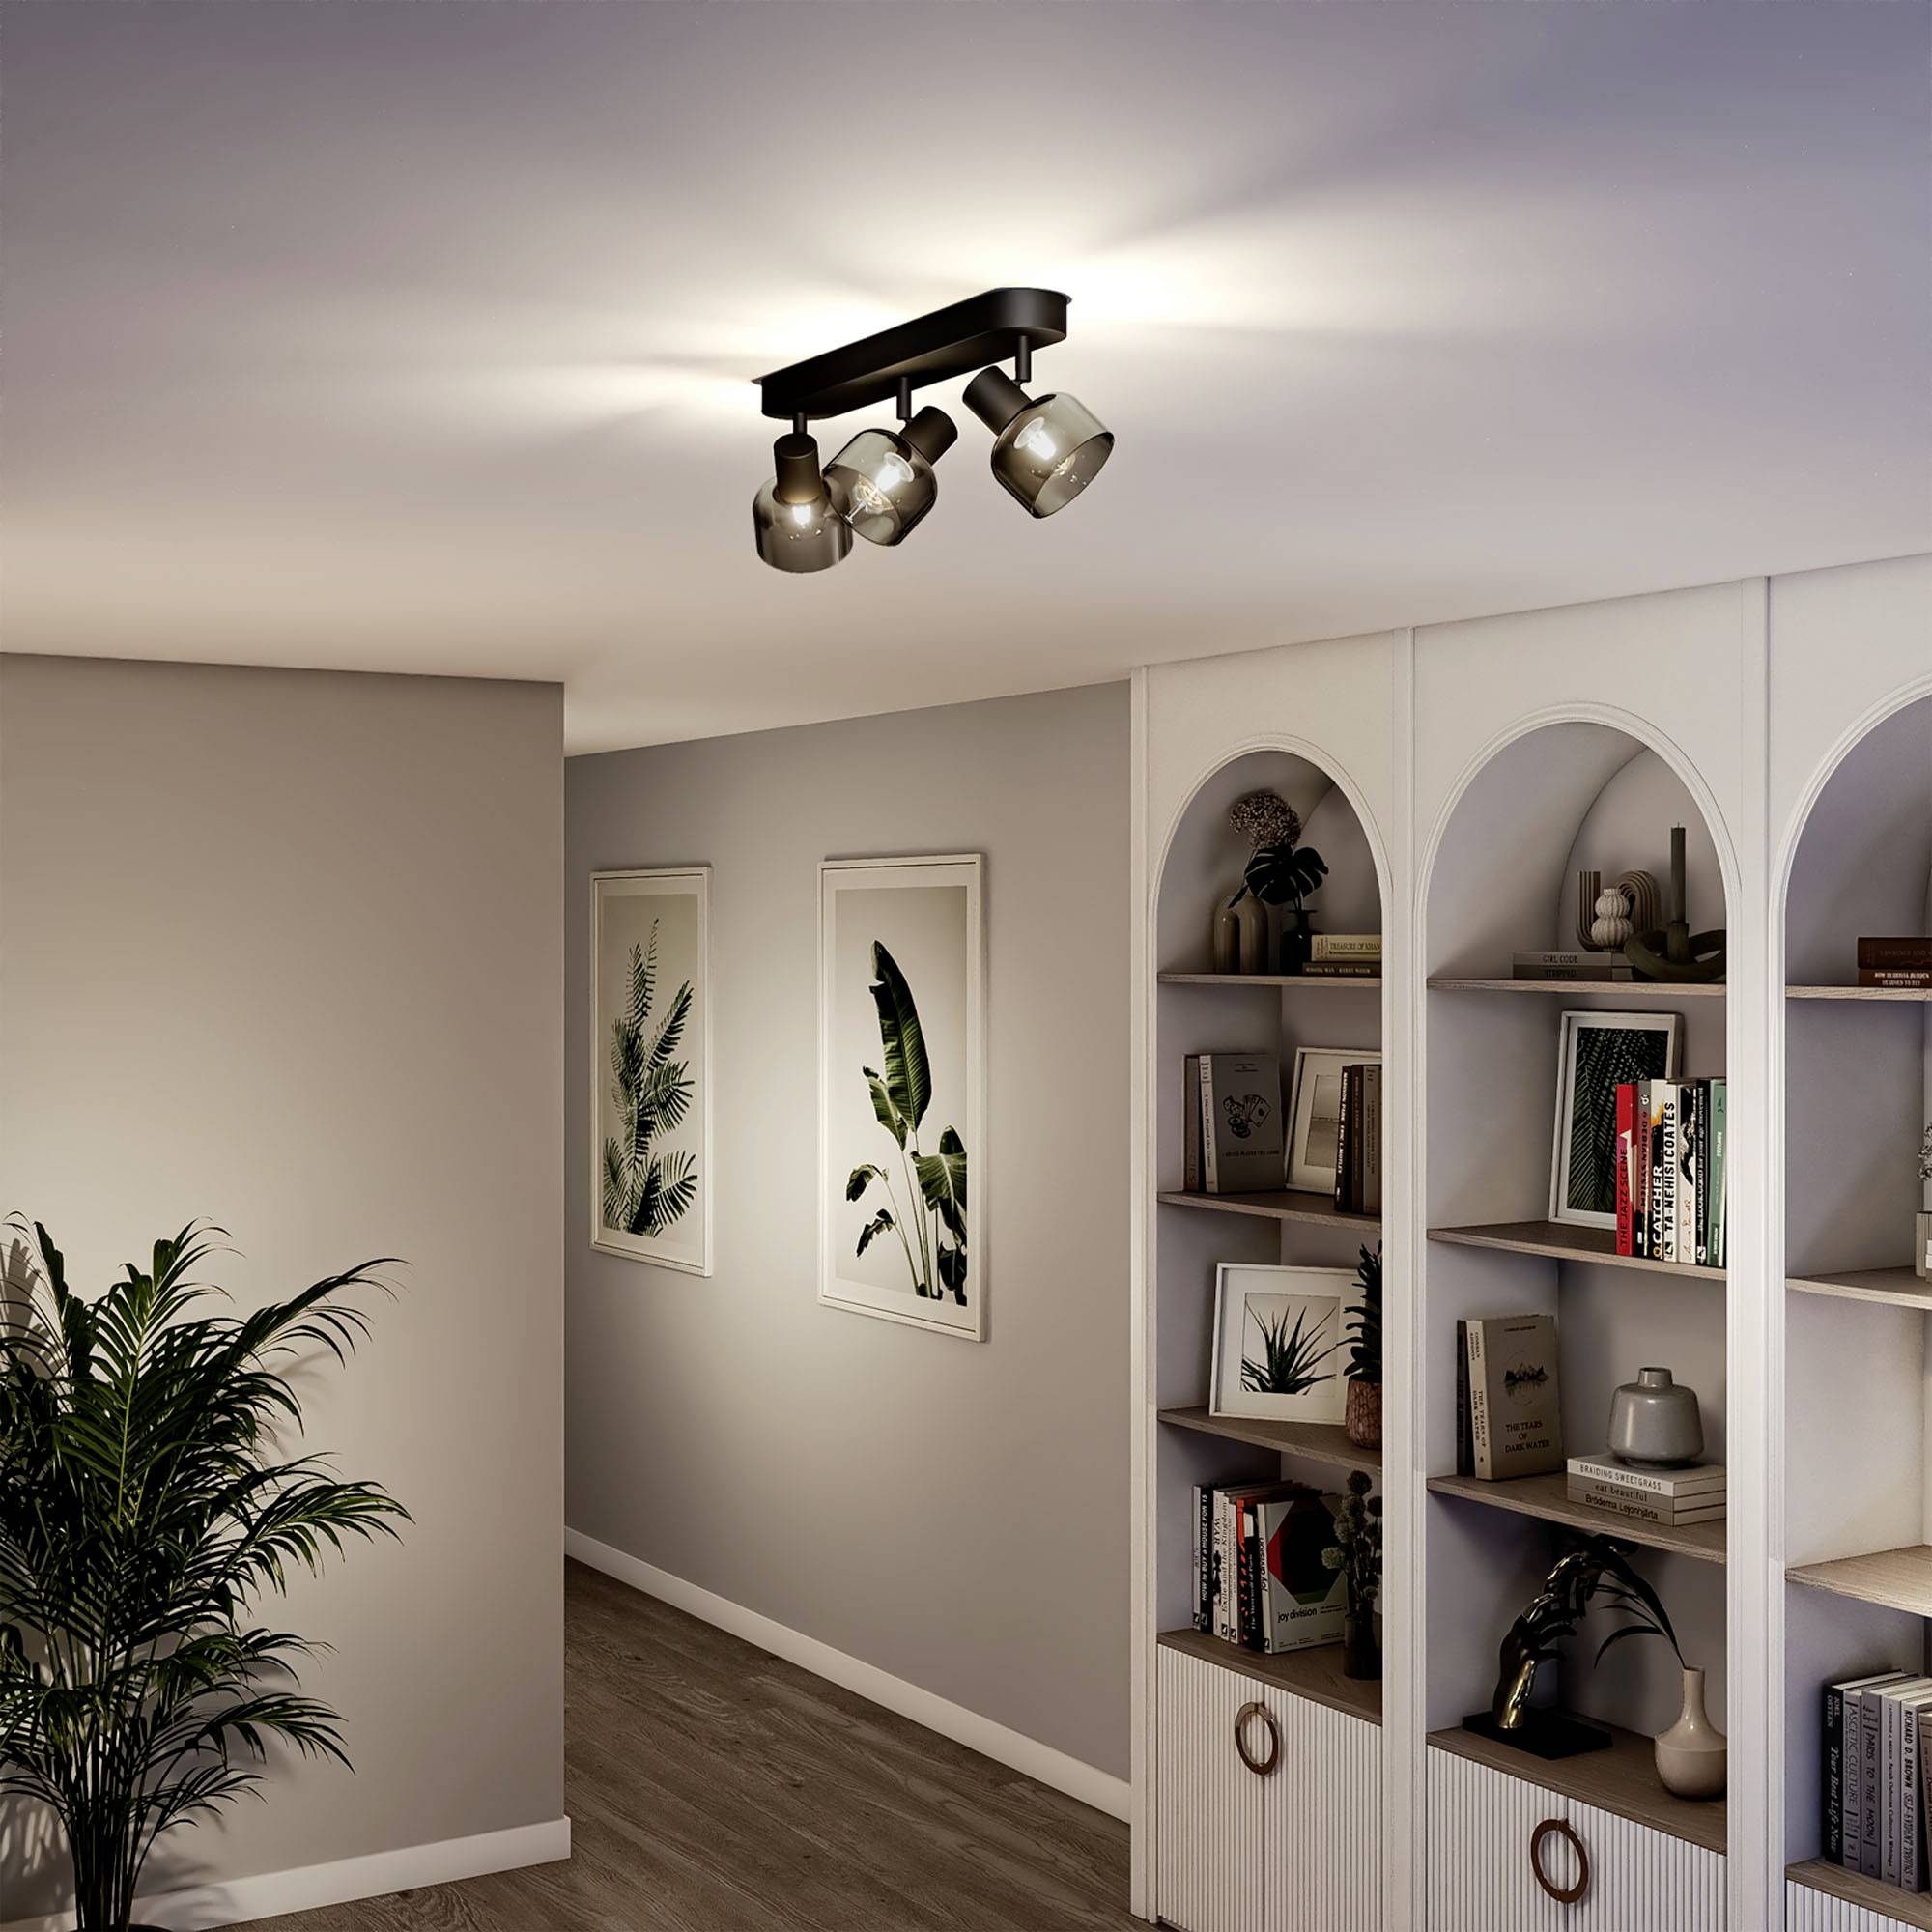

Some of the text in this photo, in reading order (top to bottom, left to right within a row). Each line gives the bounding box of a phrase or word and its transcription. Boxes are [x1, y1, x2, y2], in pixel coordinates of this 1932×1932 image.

[1559, 955, 1577, 964] CODE
[1664, 1102, 1675, 1158] COATES
[1653, 1165, 1663, 1244] CATCHER
[1505, 1420, 1544, 1433] THE TEARS
[1505, 1440, 1550, 1453] DARK WATER
[1579, 1463, 1662, 1491] BRAIDING SWEETGRASS
[1595, 1484, 1647, 1502] eat beautiful
[1260, 1577, 1268, 1592] joy
[1278, 1612, 1290, 1623] joy
[1290, 1607, 1318, 1620] division
[1904, 1709, 1913, 1744] RICHARD
[1848, 1707, 1859, 1805] ASCETIC CULTURE
[1904, 1747, 1913, 1755] D.
[1865, 1732, 1877, 1839] PARIS TO THE MOON
[1904, 1758, 1913, 1788] BROWN
[1828, 1747, 1839, 1853] Your Best Life Now
